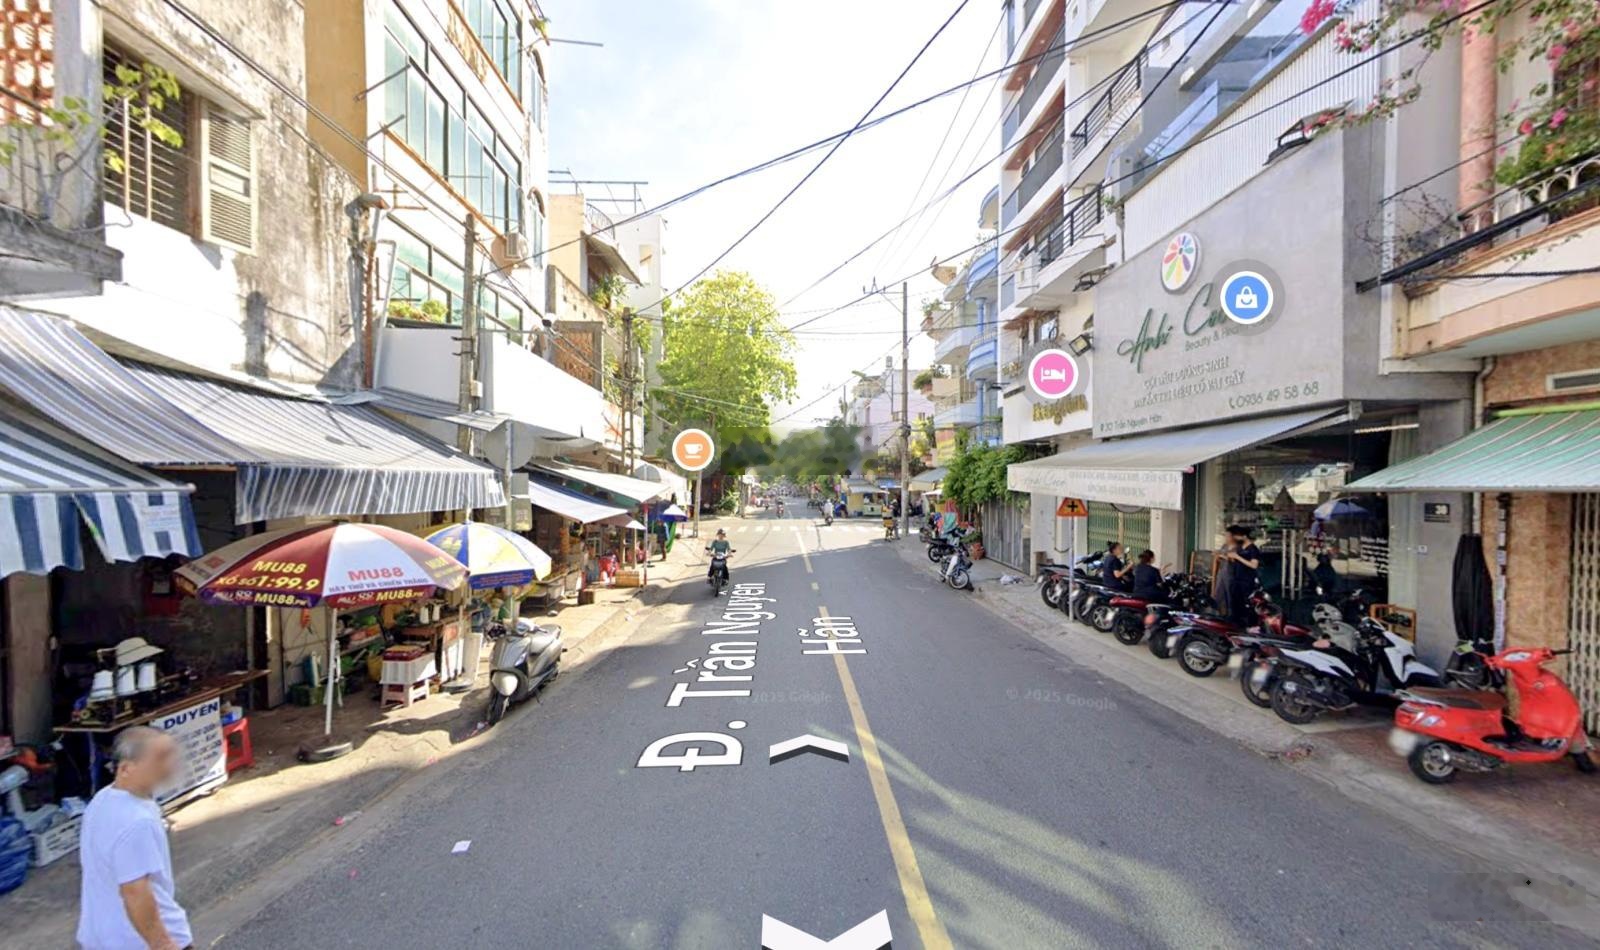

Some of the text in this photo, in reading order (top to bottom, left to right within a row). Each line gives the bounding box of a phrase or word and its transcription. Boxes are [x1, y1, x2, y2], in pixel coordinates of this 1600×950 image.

[1302, 380, 1319, 396] 68
[252, 560, 307, 574] MU88
[347, 565, 405, 581] MU88
